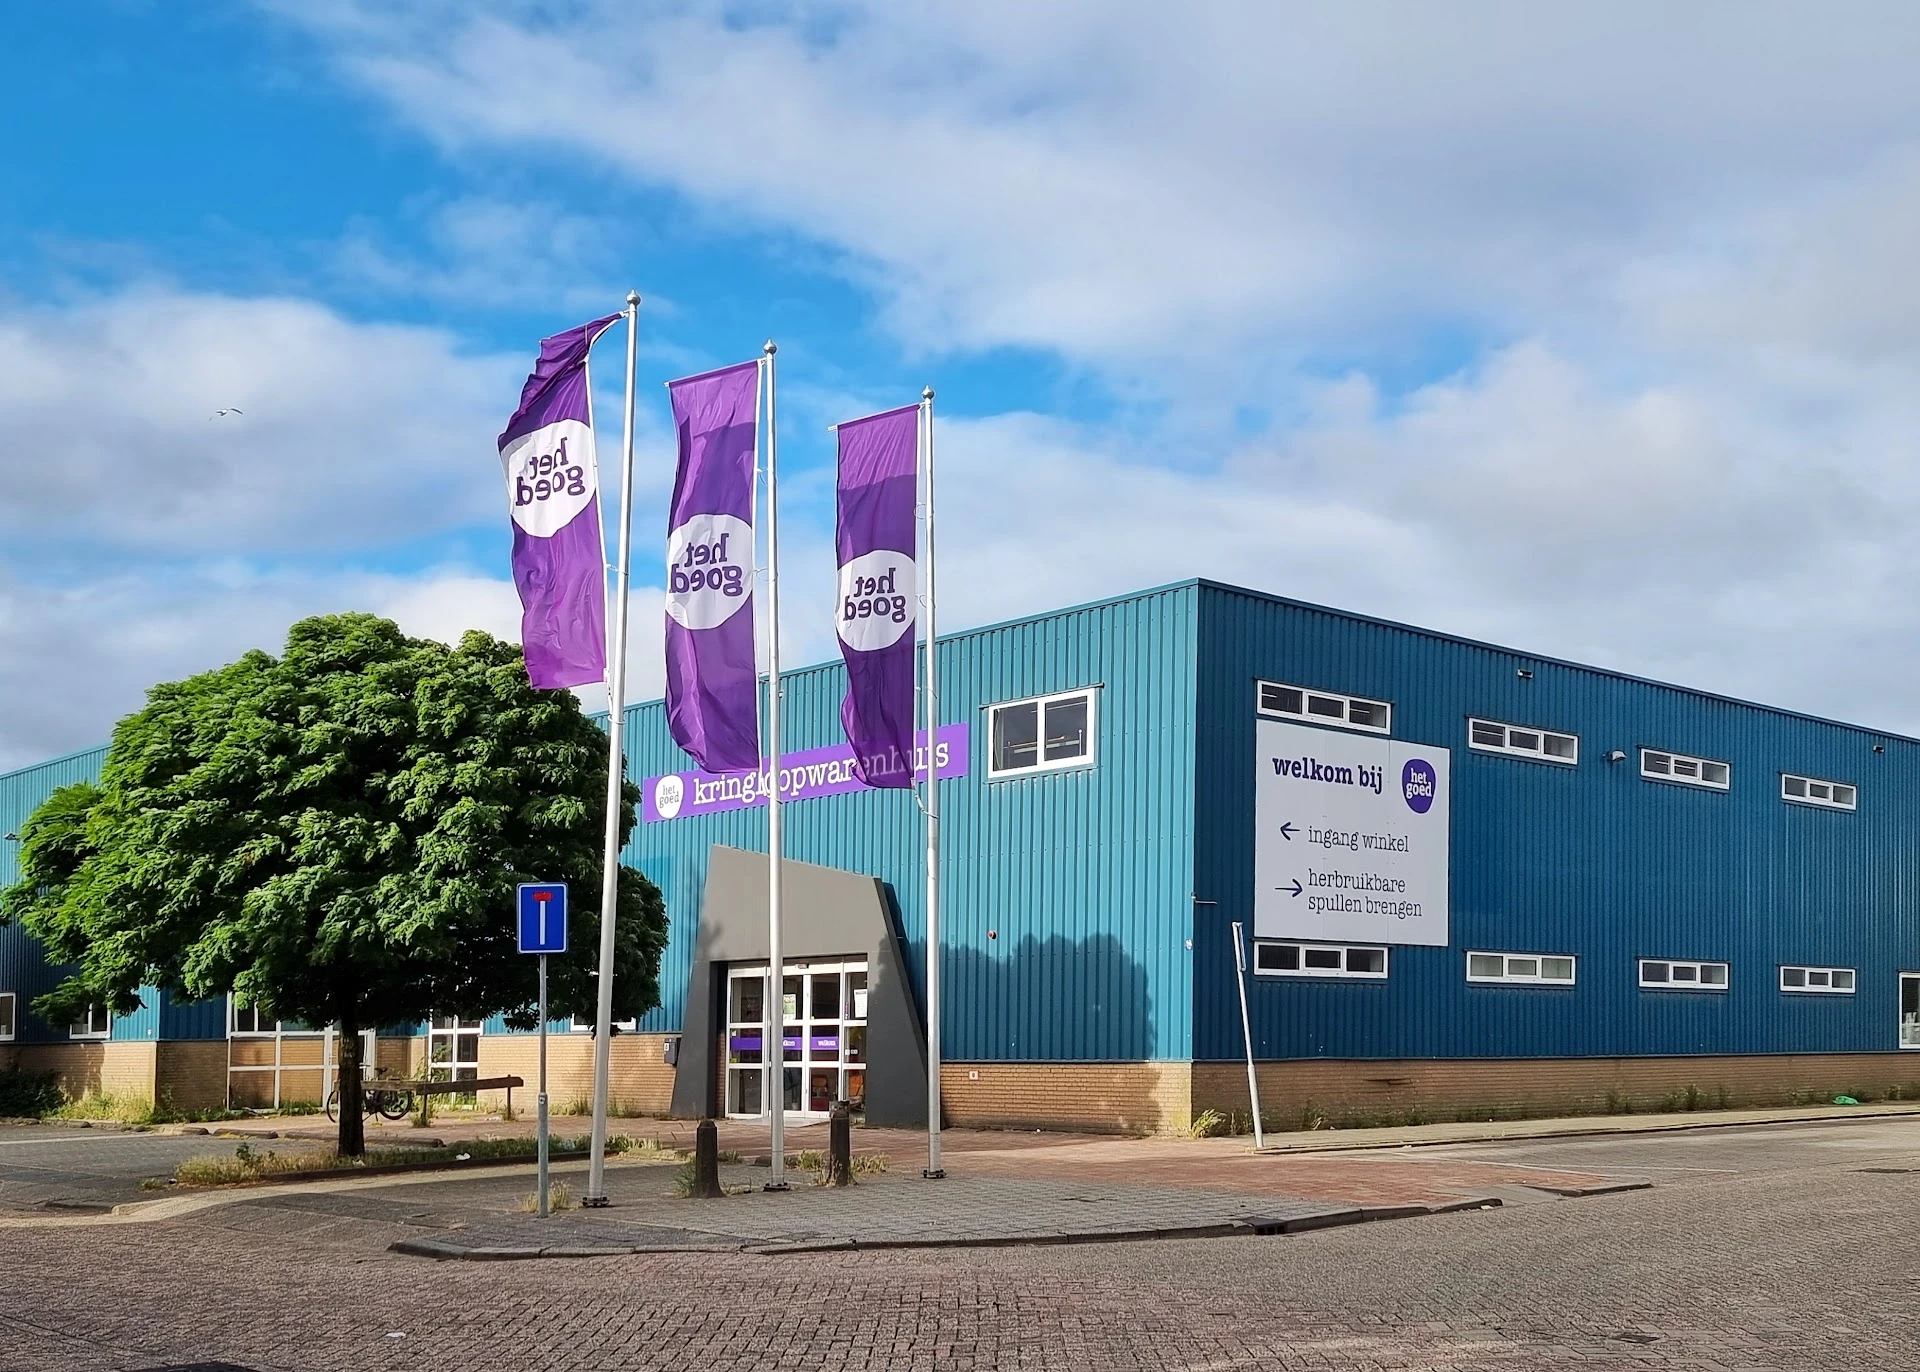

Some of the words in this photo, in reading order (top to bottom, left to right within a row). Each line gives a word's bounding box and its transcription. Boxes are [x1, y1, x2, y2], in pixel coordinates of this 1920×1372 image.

[1272, 757, 1354, 785] welkom
[1358, 764, 1383, 794] bij
[1410, 768, 1428, 784] het
[659, 790, 680, 809] goed
[662, 784, 676, 796] het
[1406, 781, 1432, 800] goed
[1308, 825, 1359, 851] ingang
[1362, 833, 1409, 852] winkel
[1308, 868, 1406, 892] herbruikbare
[1308, 894, 1362, 914] spullen
[1365, 896, 1422, 920] brengen
